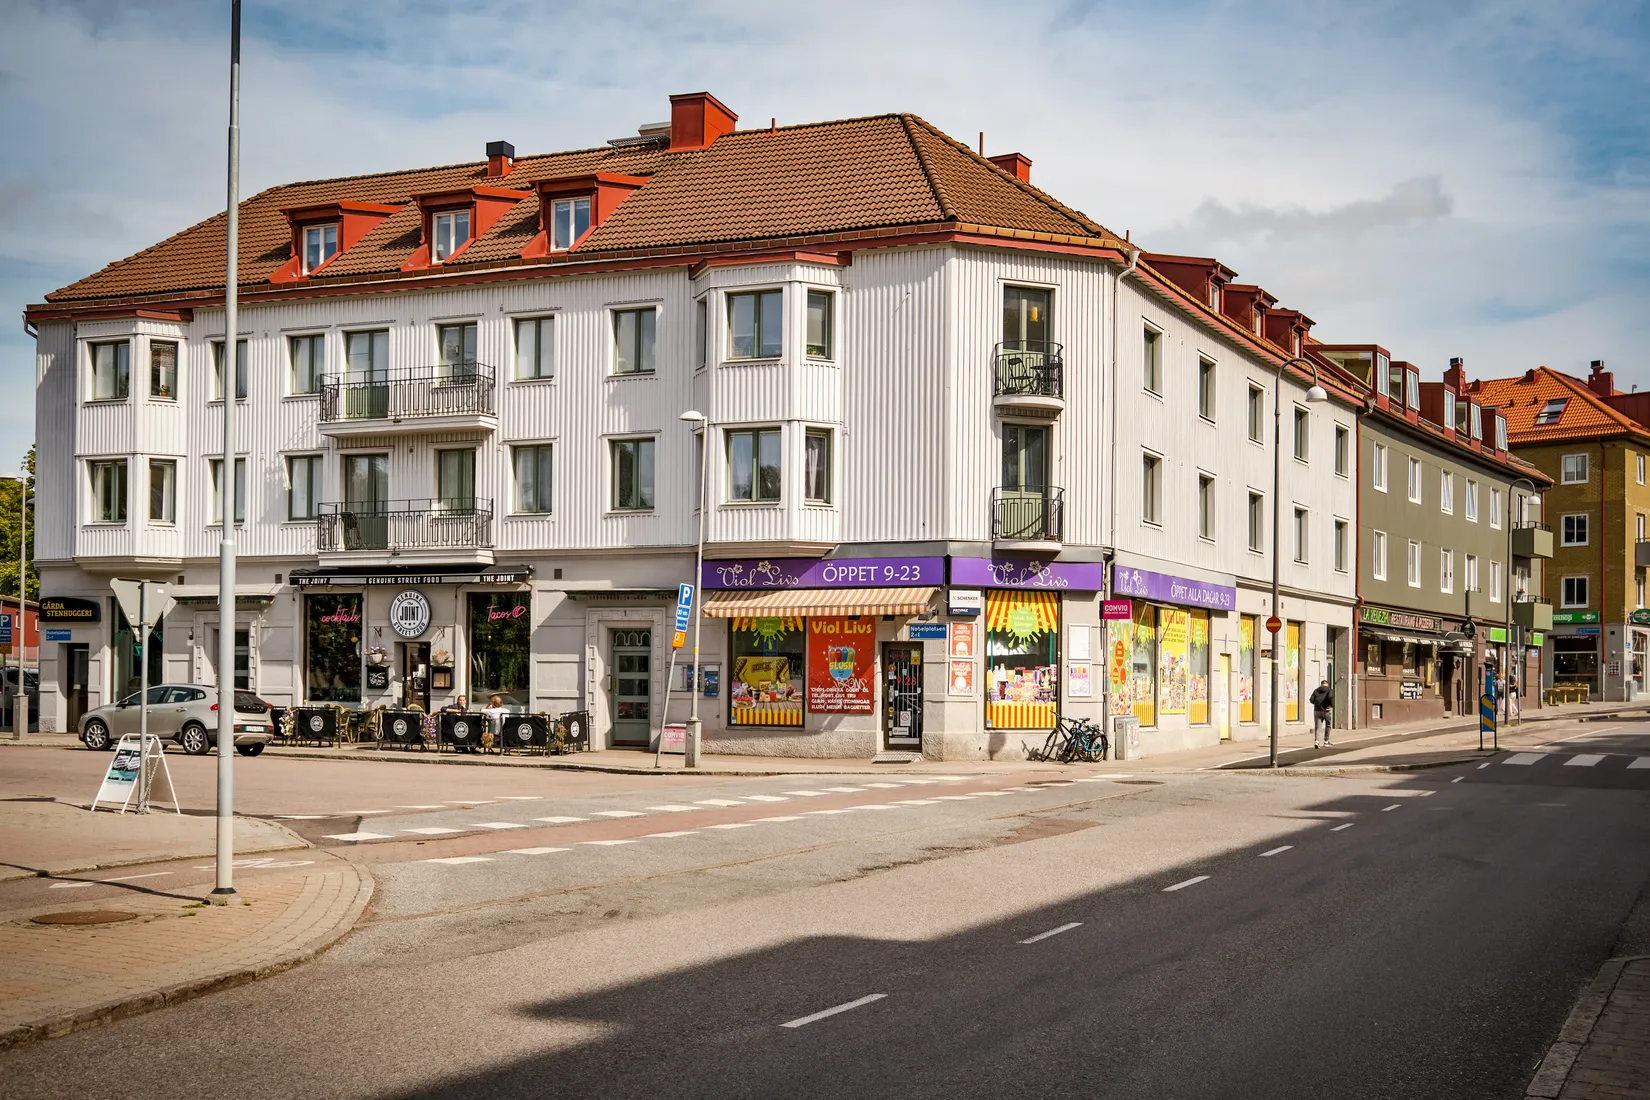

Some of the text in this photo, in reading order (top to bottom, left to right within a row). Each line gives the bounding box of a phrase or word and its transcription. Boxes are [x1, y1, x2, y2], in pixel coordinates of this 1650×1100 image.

[716, 564, 799, 587] Viol Livs
[822, 563, 921, 582] ÖPPET 9-23
[987, 563, 1069, 587] Viol Livs
[1119, 571, 1148, 596] Viol Livs
[397, 592, 423, 603] GENUINE
[682, 586, 691, 604] P
[1171, 581, 1230, 606] ÖPPET ALLA DAGAR 9-23
[42, 601, 65, 610] GÅRDA
[321, 603, 360, 624] cocktails
[400, 606, 419, 621] JOINT
[487, 605, 511, 622] Tacos
[1104, 604, 1128, 612] COMVIQ
[393, 621, 412, 636] STREET
[811, 621, 872, 634] Viol Livs
[829, 661, 854, 670] SLUSH
